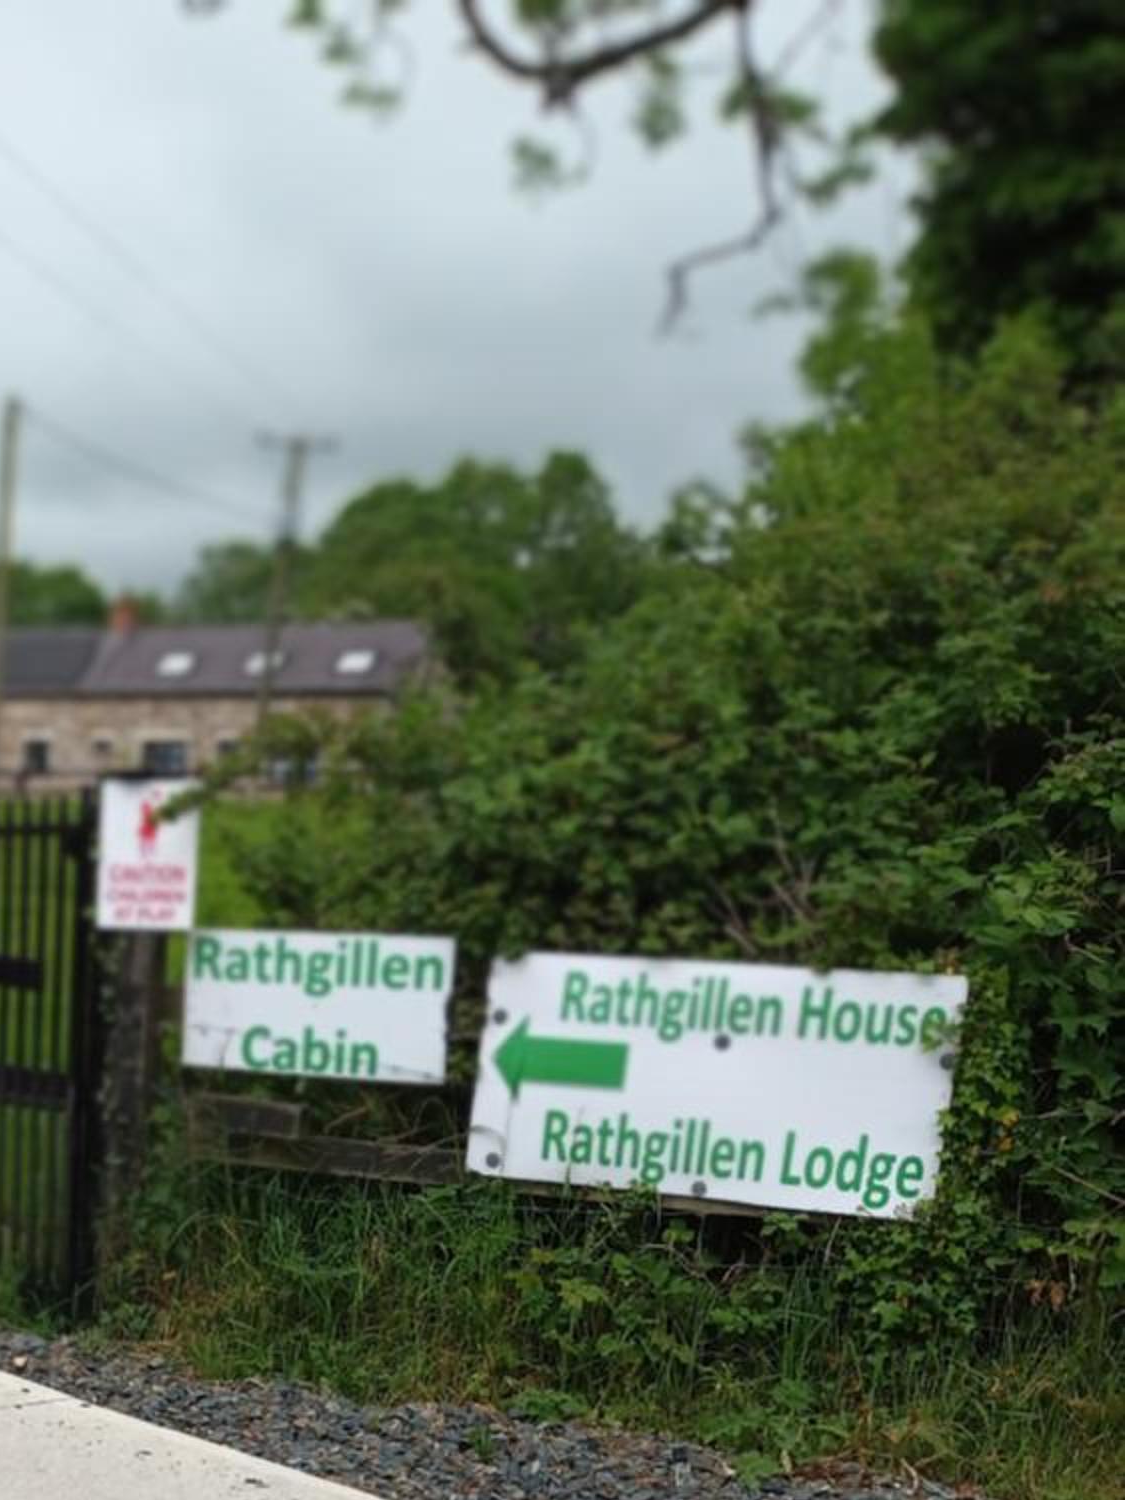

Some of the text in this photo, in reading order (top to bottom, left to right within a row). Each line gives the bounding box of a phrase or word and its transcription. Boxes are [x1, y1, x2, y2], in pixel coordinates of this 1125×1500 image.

[109, 863, 187, 883] CAUTION
[192, 936, 446, 998] Rathgillen
[559, 969, 950, 1048] Rathgillen House
[240, 1025, 379, 1076] Cabin
[540, 1108, 925, 1210] Rathgillen Lodge
